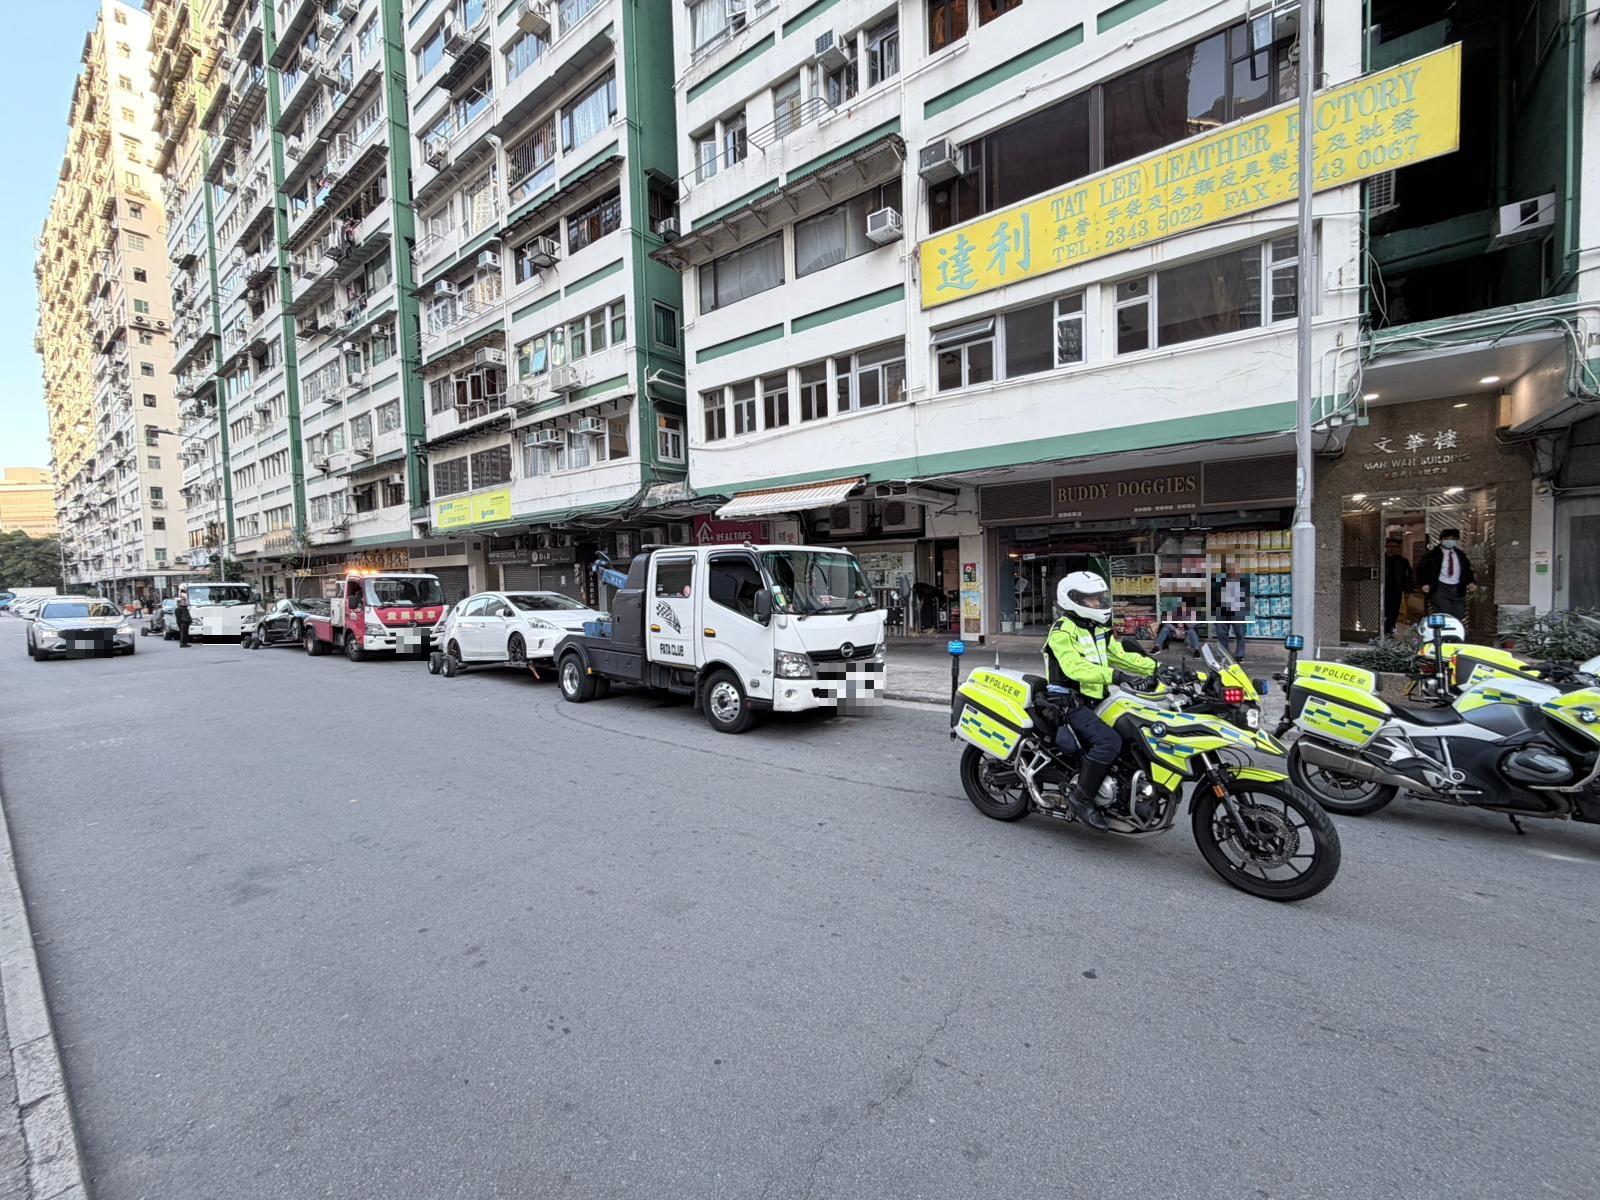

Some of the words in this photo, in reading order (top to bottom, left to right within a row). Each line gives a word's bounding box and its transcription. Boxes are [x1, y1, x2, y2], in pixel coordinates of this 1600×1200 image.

[1051, 189, 1088, 223] TAT
[1099, 169, 1142, 207] LEE
[1153, 124, 1272, 188] LEATHER
[1286, 67, 1422, 143] FCTORY
[1105, 219, 1149, 248] 2343
[1157, 203, 1204, 231] 5022
[1288, 158, 1346, 192] 243
[1357, 134, 1421, 169] 0067
[936, 212, 1031, 291] 達利
[1363, 461, 1387, 470] MAN
[1392, 458, 1416, 468] WAH
[1058, 483, 1109, 502] BUDDY
[1117, 475, 1197, 497] DOGGIES
[717, 532, 753, 541] REALTORS
[989, 677, 1014, 695] POLICE
[1322, 667, 1357, 683] POLICE
